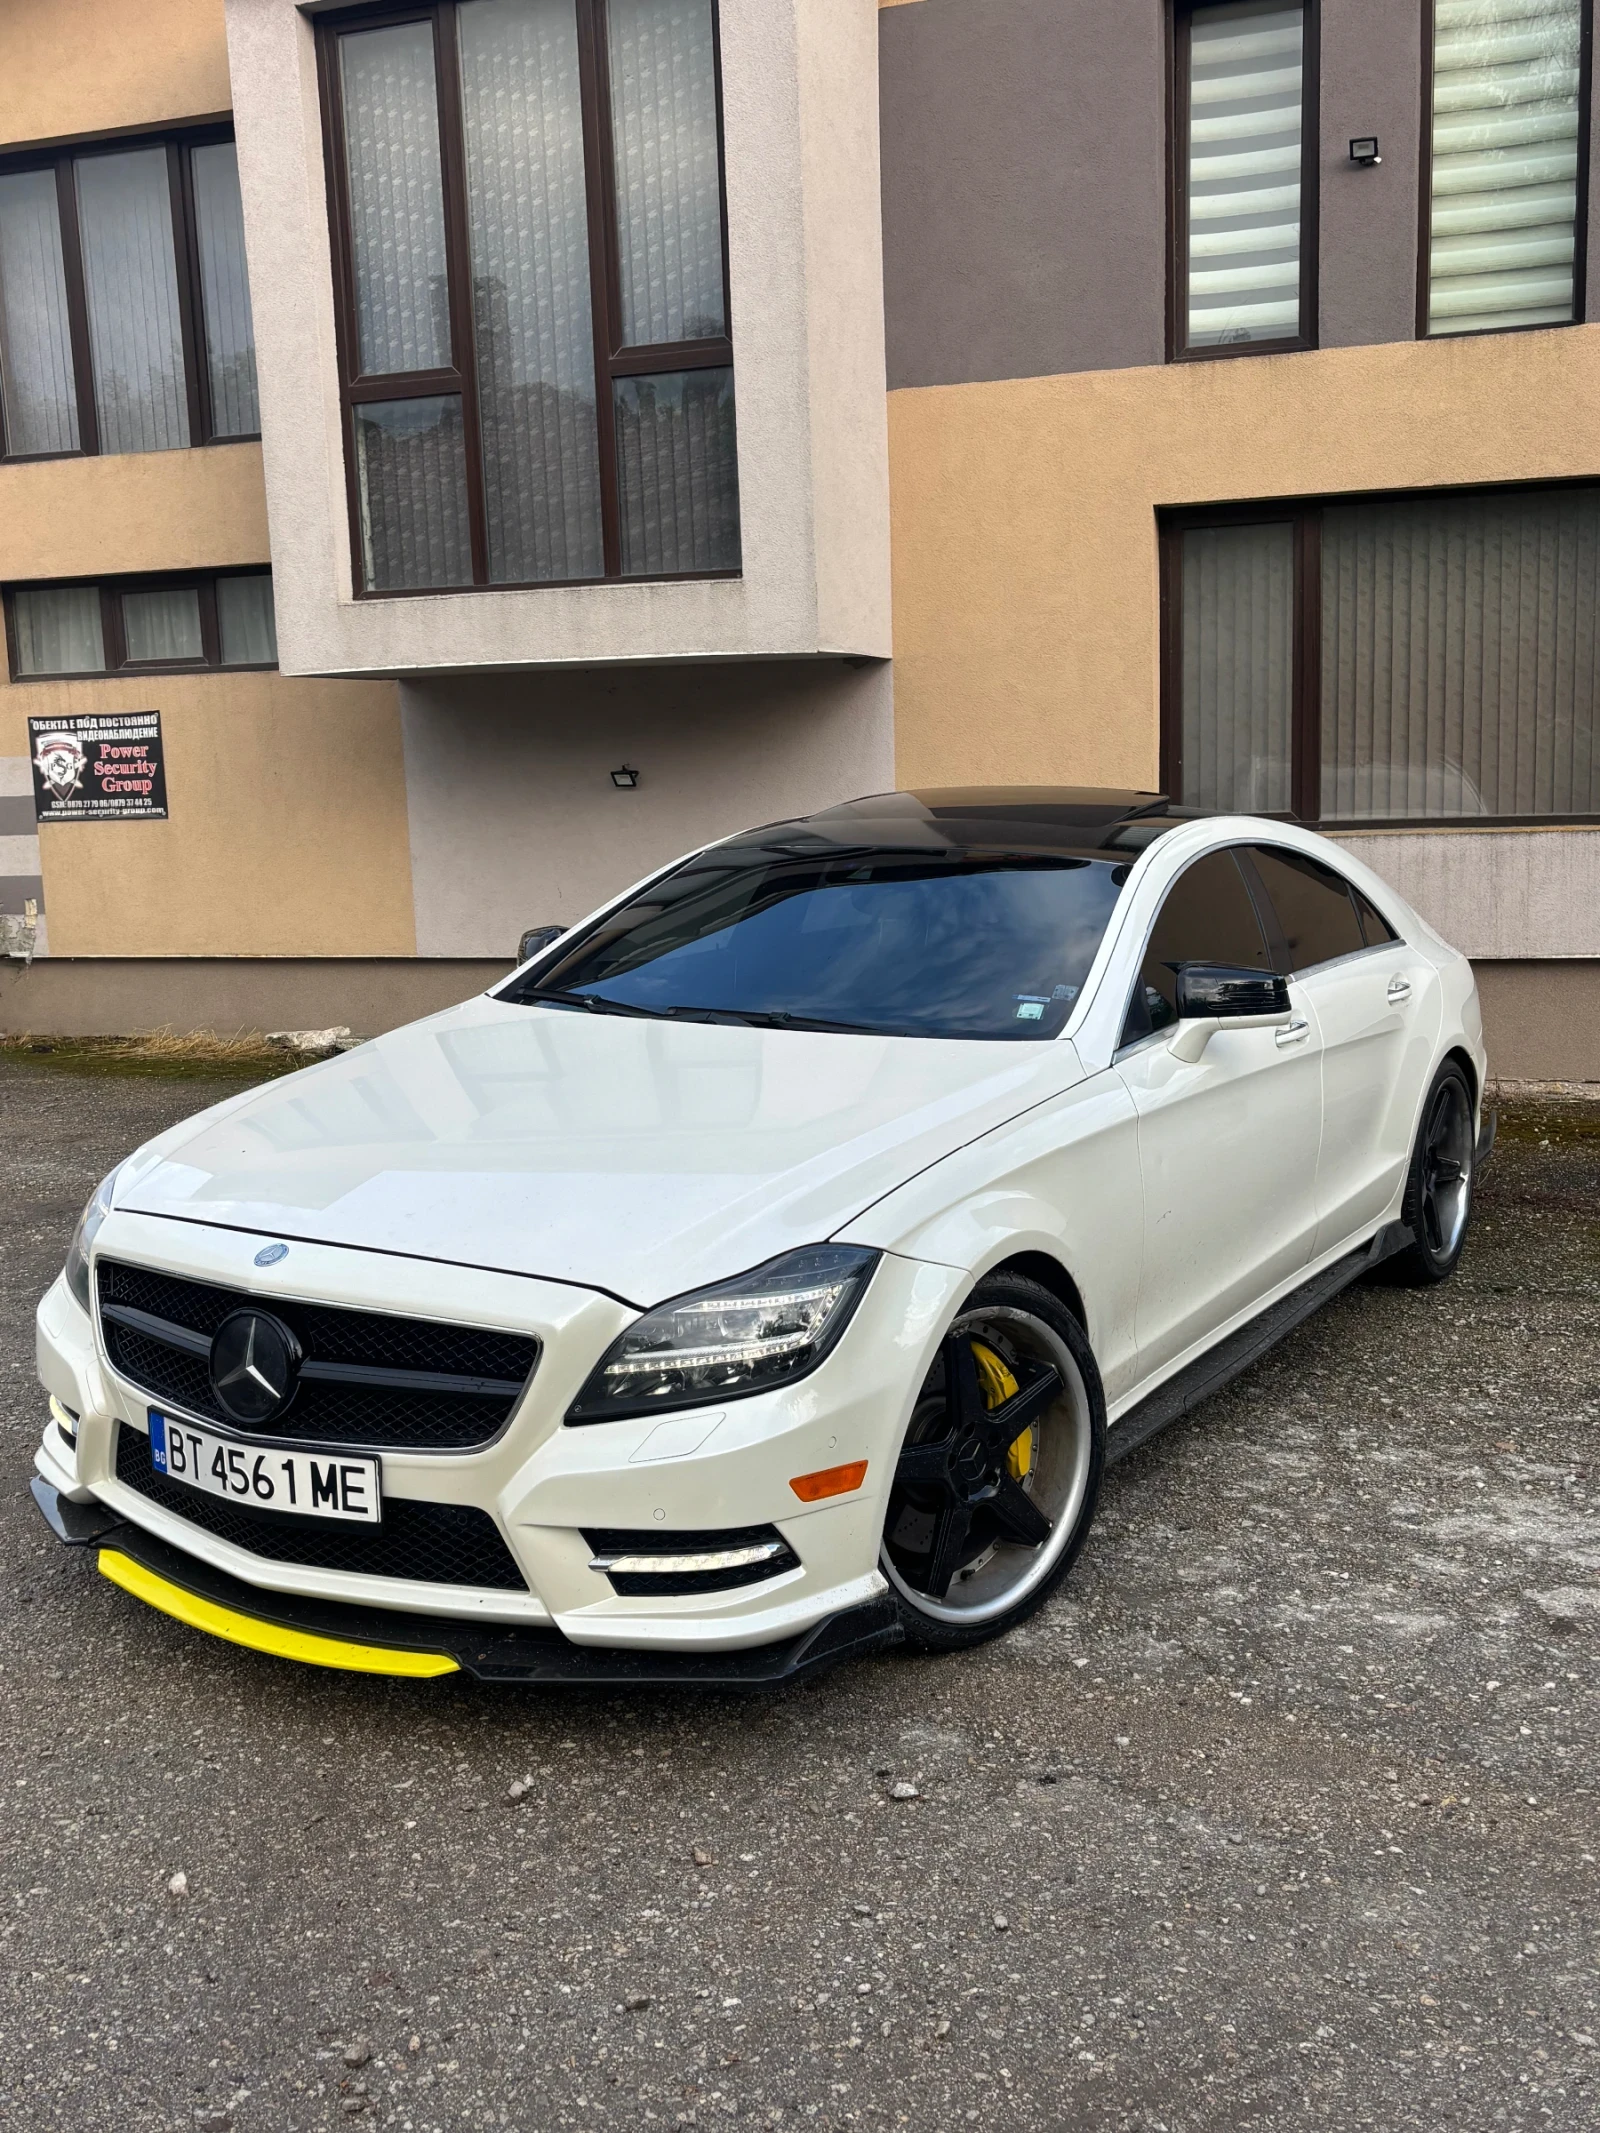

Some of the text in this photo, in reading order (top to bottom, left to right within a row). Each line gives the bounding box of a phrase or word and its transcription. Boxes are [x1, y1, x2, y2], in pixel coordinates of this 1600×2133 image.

[32, 714, 158, 730] ОБЕКТА Е ПОД ПОСТОЯННО
[77, 727, 158, 742] ВИДЕОНАБЛЮДЕНИЕ
[99, 743, 149, 759] Power
[93, 760, 158, 777] Security
[101, 777, 153, 795] Group
[155, 1450, 166, 1465] BG
[168, 1425, 369, 1514] BT 4561 ME
